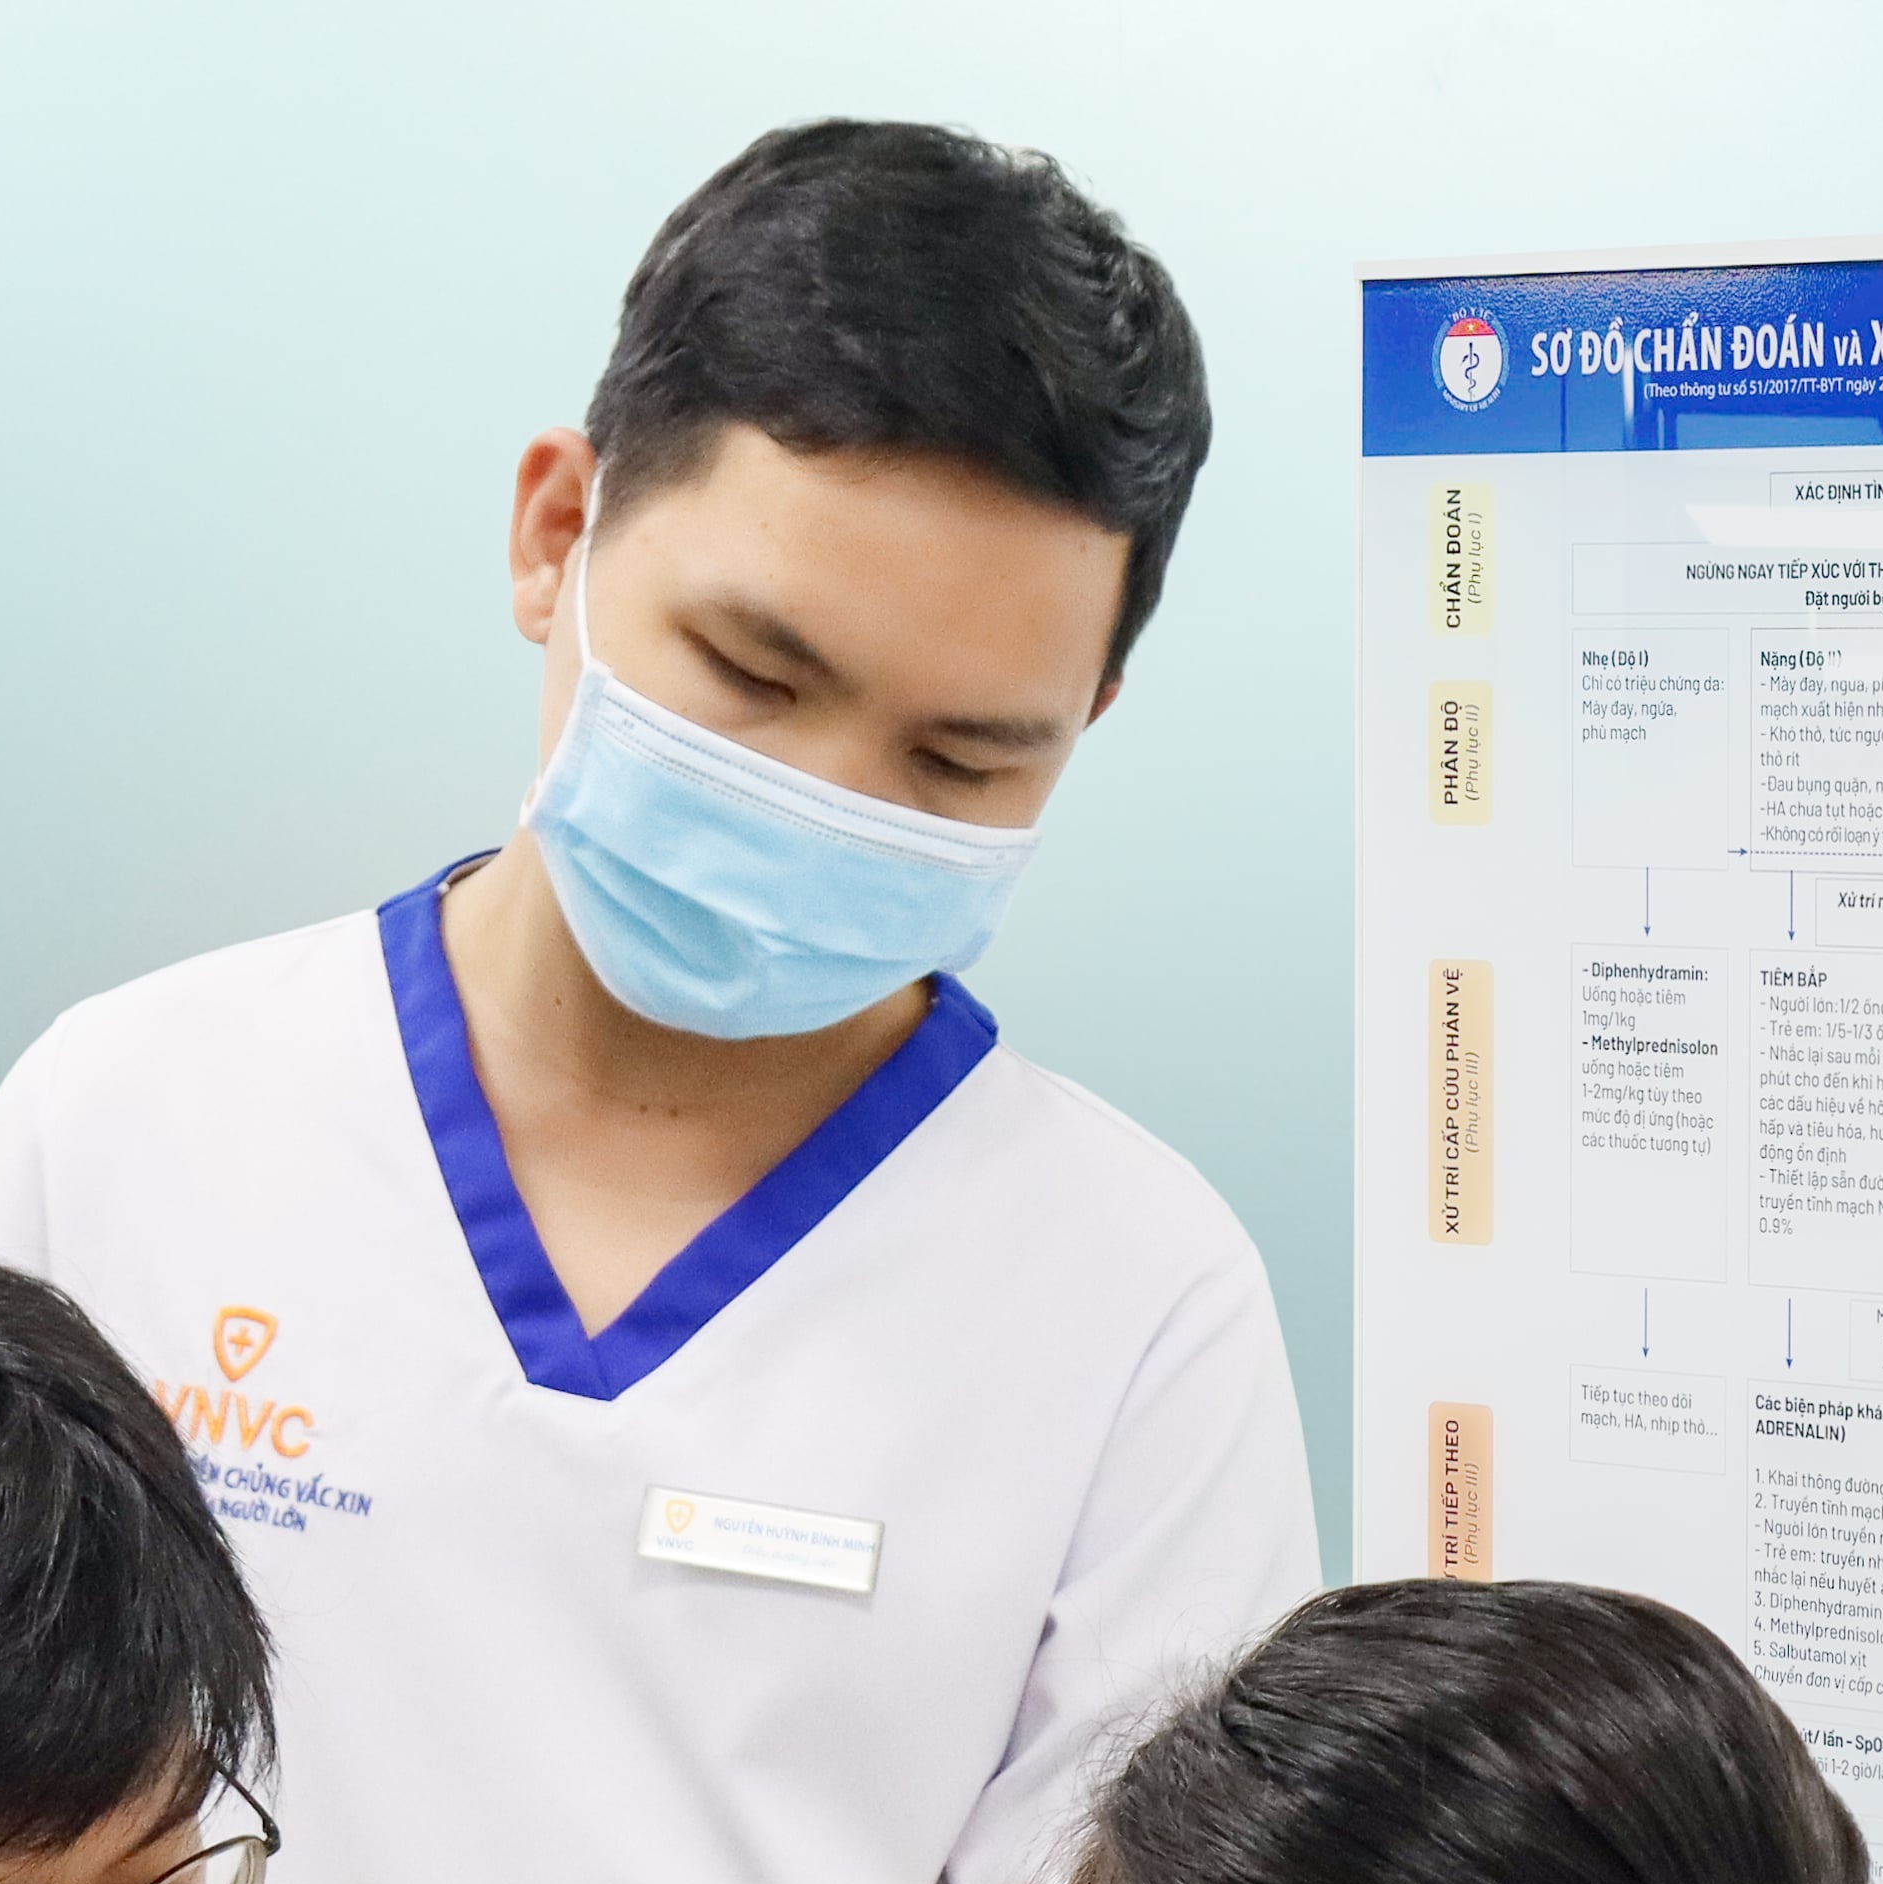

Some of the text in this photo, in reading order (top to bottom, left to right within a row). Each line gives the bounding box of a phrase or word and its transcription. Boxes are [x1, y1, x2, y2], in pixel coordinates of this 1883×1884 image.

[1531, 327, 1573, 376] SƠ
[1579, 317, 1625, 375] ĐỒ
[1632, 312, 1722, 373] CHẨN
[1731, 314, 1825, 370] ĐOÁN
[1833, 330, 1863, 367] VÀ
[1643, 381, 1678, 402] (Theo
[1680, 380, 1717, 401] thông
[1718, 382, 1731, 396] tư
[1732, 377, 1749, 396] số
[1749, 375, 1844, 396] 51/2017/TT-BYT
[1845, 375, 1877, 397] ngày
[1795, 480, 1824, 501] XÁC
[1827, 483, 1862, 506] ĐỊNH
[1439, 489, 1462, 629] CHẨN ĐOÁN
[1737, 563, 1775, 581] NGAY
[1777, 557, 1809, 580] TIẾP
[1842, 559, 1866, 580] VỚI
[1805, 589, 1829, 611] Đặt
[1831, 589, 1870, 611] người
[1440, 700, 1463, 805] PHÂN ĐỘ
[1760, 964, 1828, 988] TIÊM BẮP
[1441, 967, 1464, 1235] XỬ TRÍ CẤP CỨU PHẢN VỆ
[154, 1379, 314, 1459] VNVC
[1445, 1420, 1460, 1475] THEO
[224, 1462, 291, 1498] CHỦNG
[296, 1473, 335, 1507] VẮC
[335, 1489, 373, 1517] XIN
[1440, 1482, 1459, 1529] TIẾP
[219, 1496, 271, 1522] NGƯỜI
[272, 1504, 307, 1532] LỚN
[656, 1536, 695, 1552] VNVC
[1442, 1535, 1459, 1568] TRÍ
